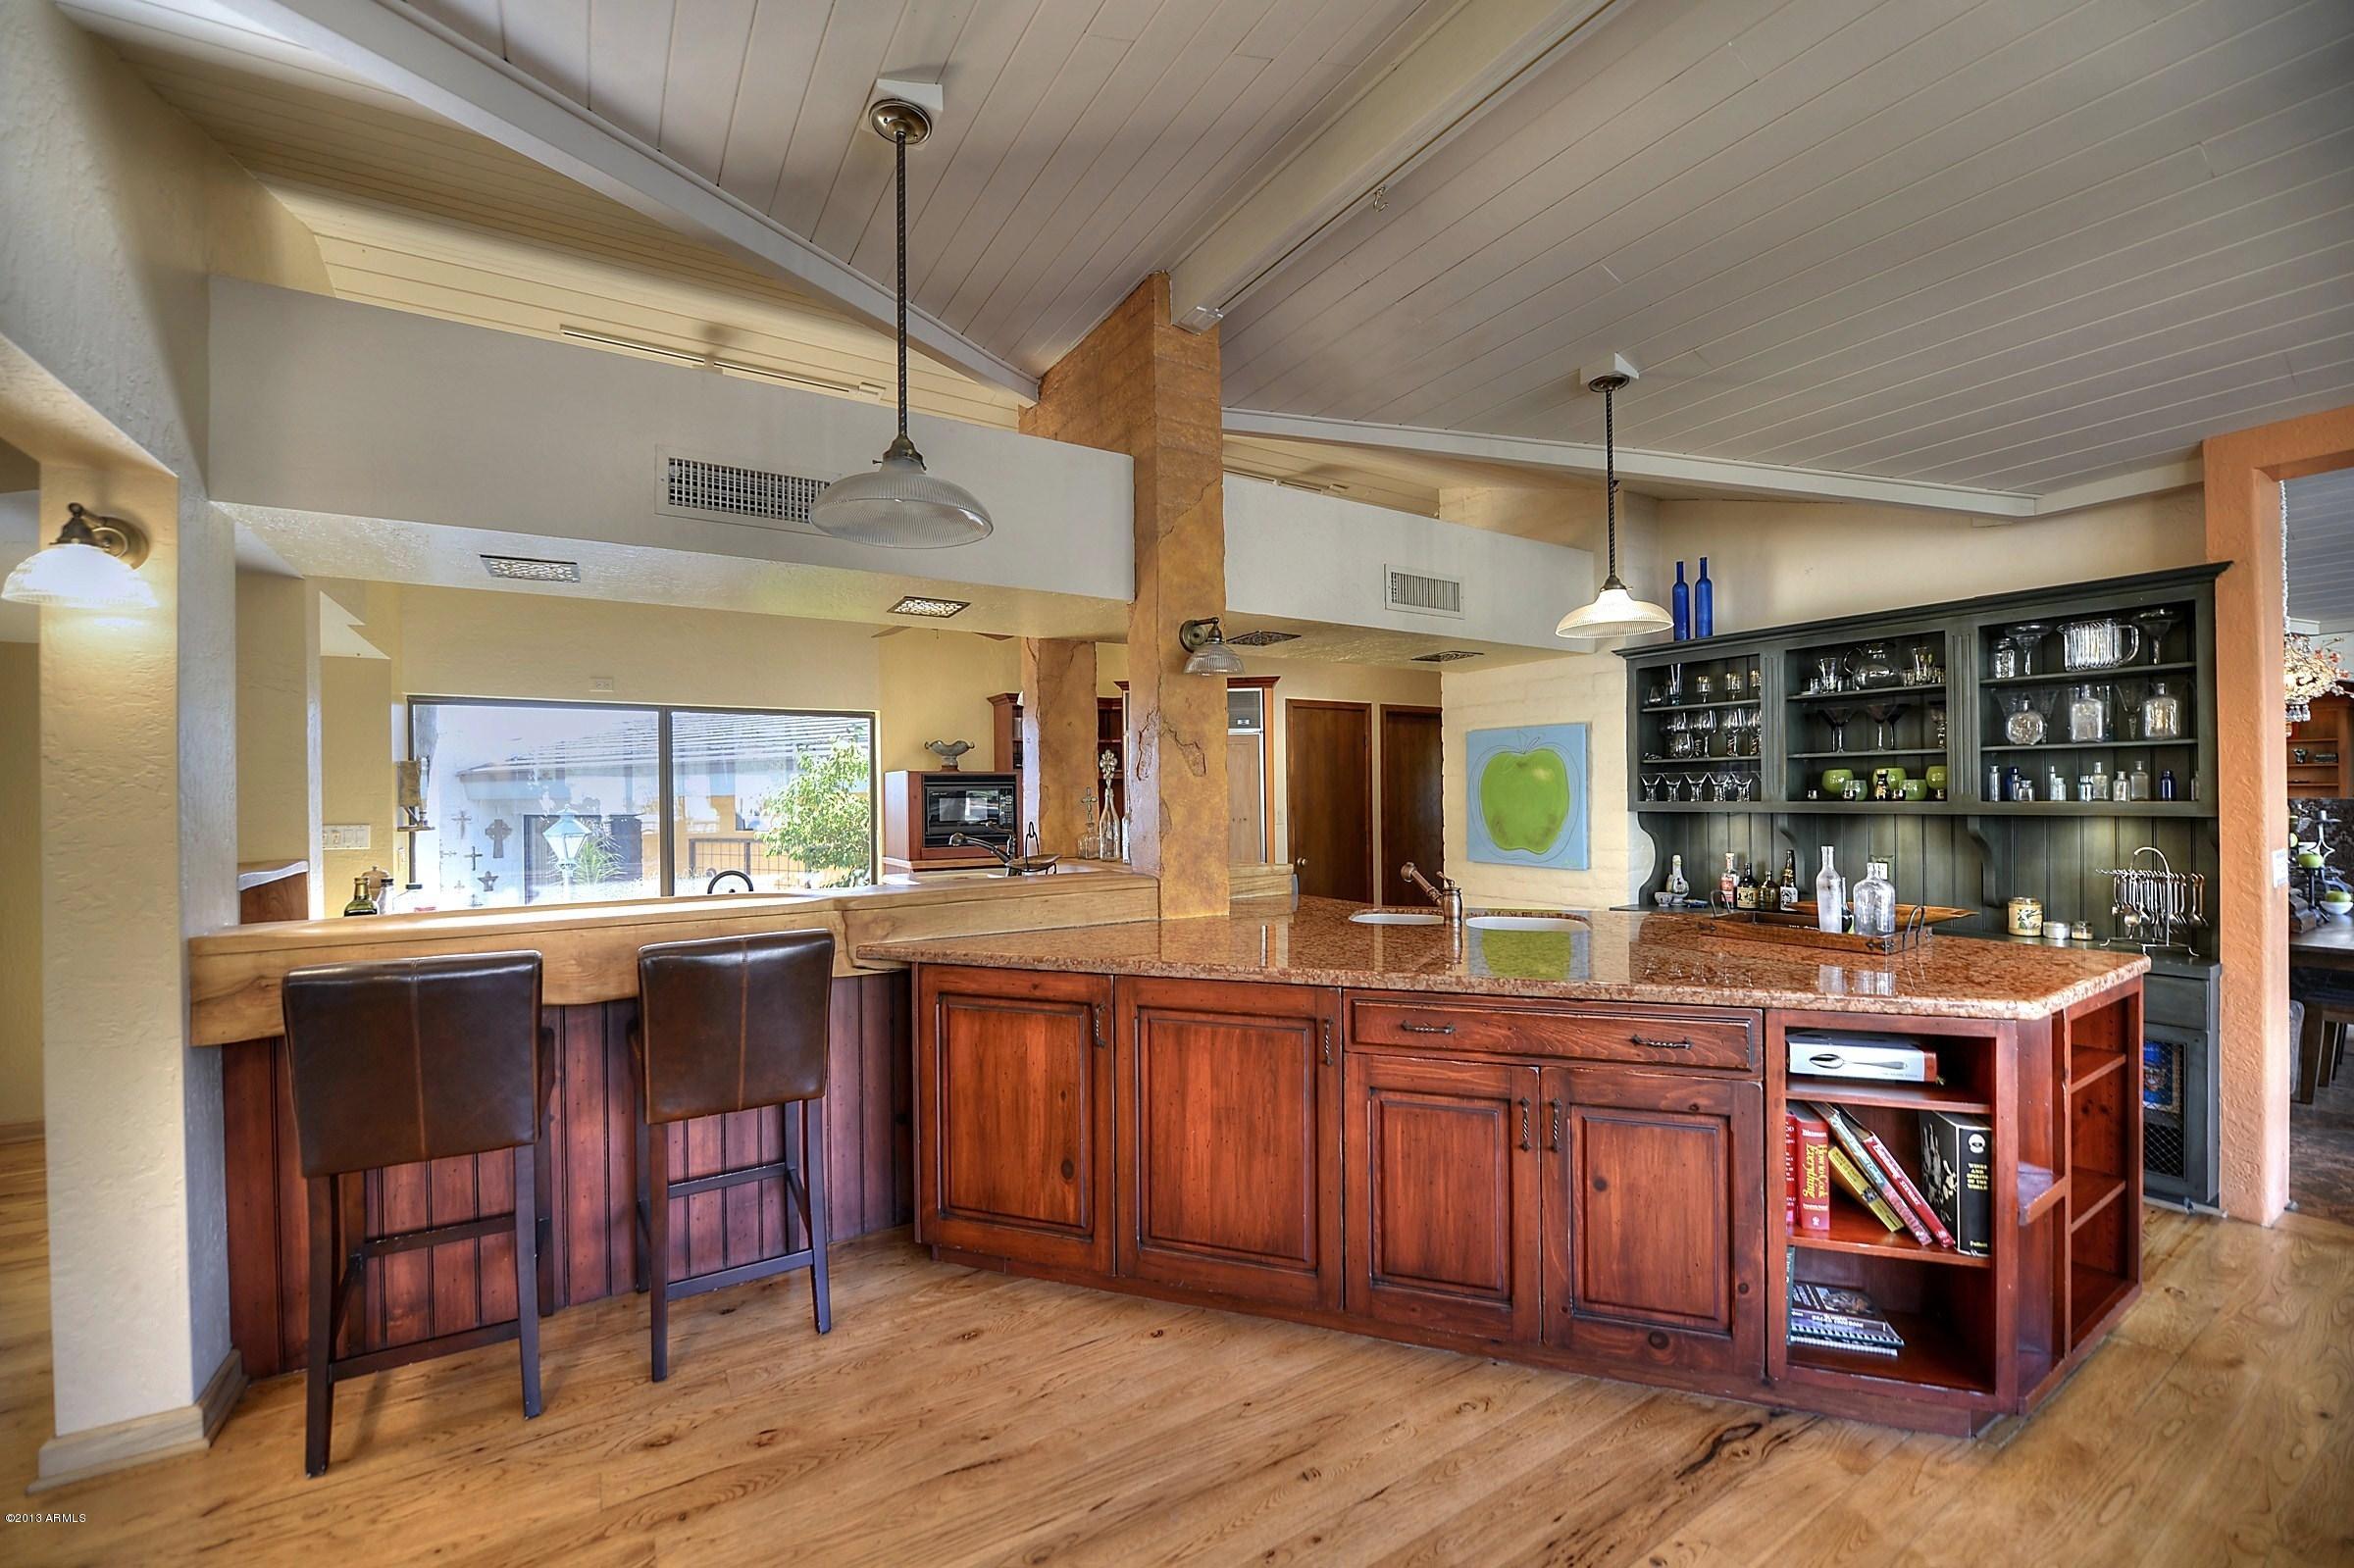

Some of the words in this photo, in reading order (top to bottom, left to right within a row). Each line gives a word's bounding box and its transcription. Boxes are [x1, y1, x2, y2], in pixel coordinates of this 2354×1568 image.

[1817, 1144, 1828, 1166] How
[1803, 1142, 1818, 1198] Everything
[1817, 1174, 1829, 1198] Cook
